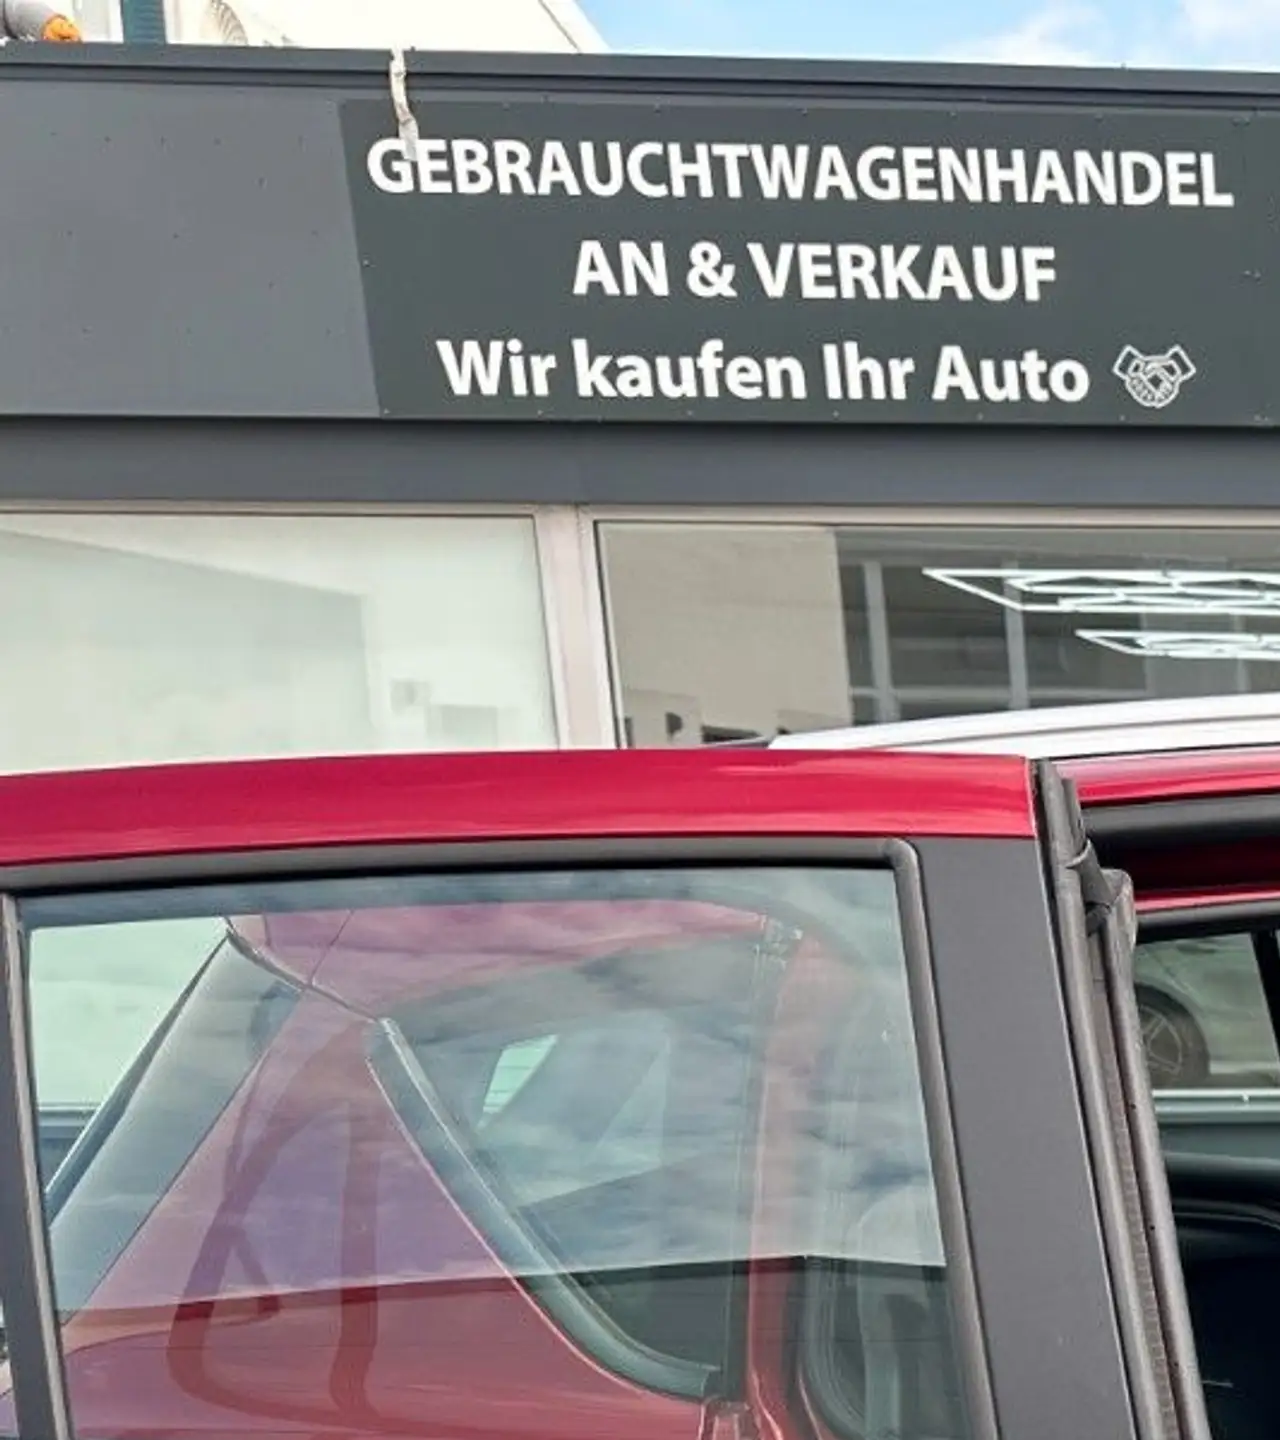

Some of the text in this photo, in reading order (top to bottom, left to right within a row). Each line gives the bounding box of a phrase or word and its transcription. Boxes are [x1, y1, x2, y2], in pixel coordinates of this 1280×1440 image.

[368, 139, 1234, 206] GEBRAUCHTWAGENHANDEL
[573, 240, 1056, 302] AN & VERKAUF
[436, 338, 1089, 402] Wir kaufen Ihr Auto
